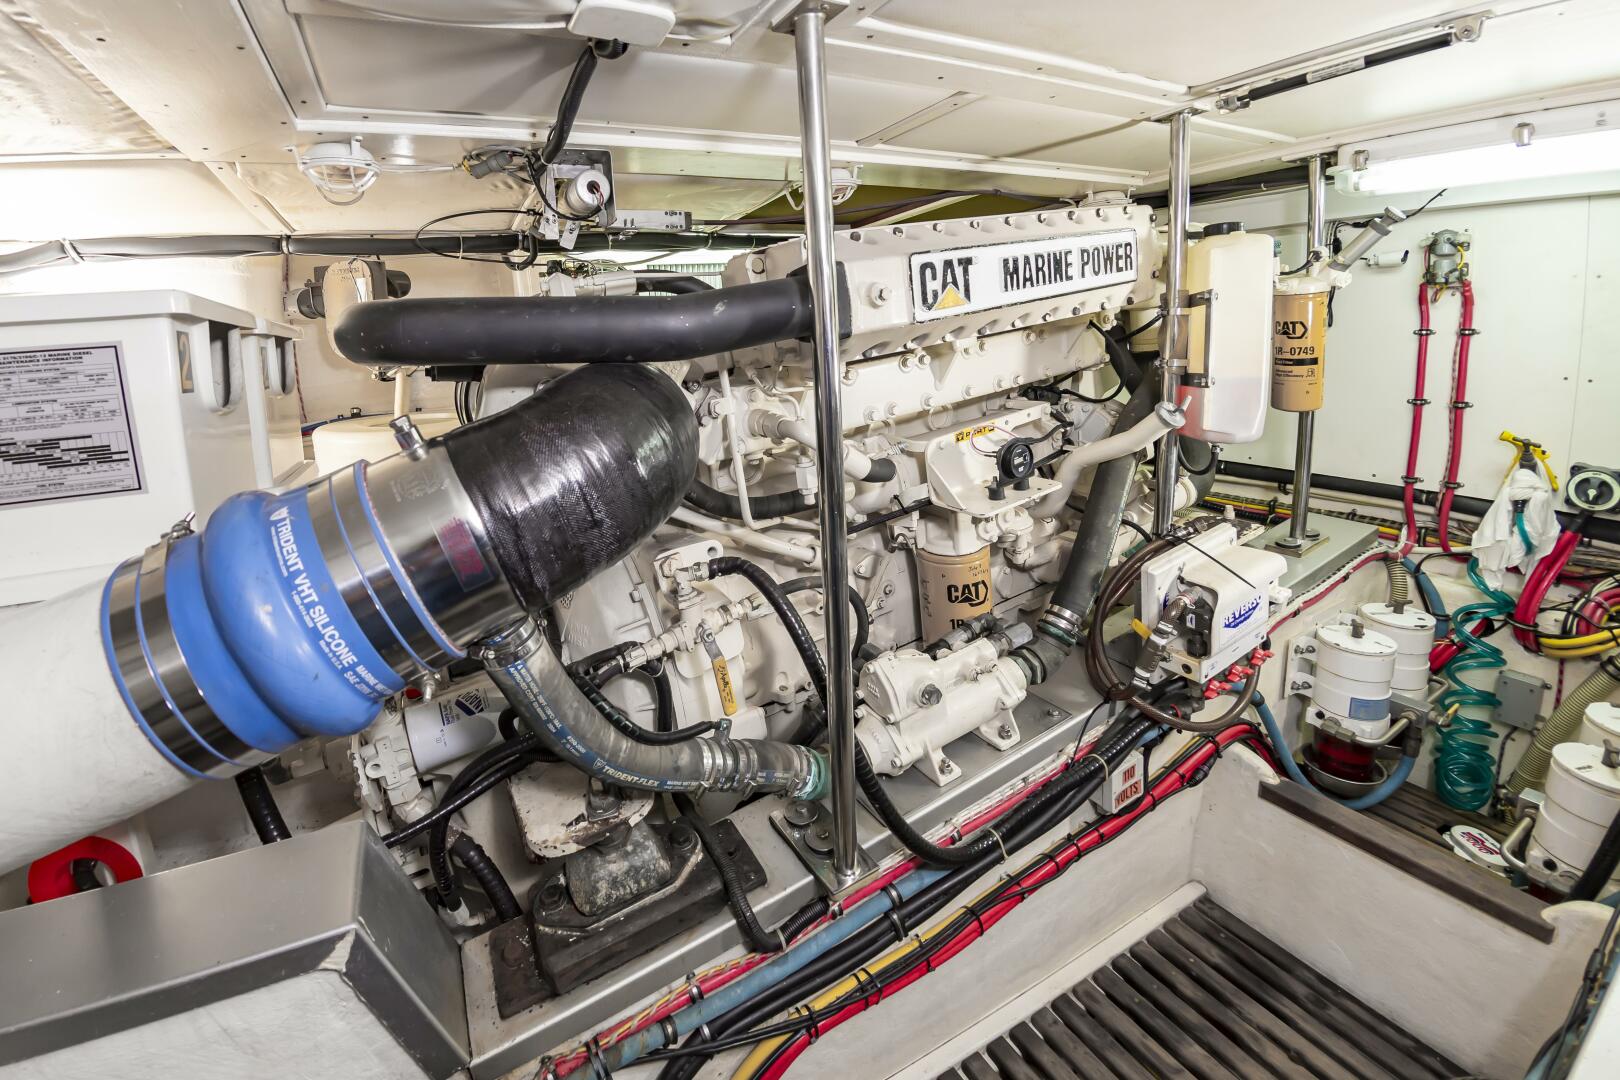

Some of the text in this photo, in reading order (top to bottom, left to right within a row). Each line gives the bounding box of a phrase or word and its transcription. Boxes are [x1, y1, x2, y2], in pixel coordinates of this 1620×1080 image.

[919, 241, 1133, 311] CAT MARINE POWER
[1275, 321, 1299, 336] CAT
[1275, 346, 1315, 356] 1R-0749
[277, 519, 358, 668] TRIDENT VHT SILICONE
[947, 582, 981, 604] CAT
[344, 670, 360, 685] SAE
[602, 765, 660, 788] TRIDENT-FLEX
[1115, 780, 1140, 807] VOLTS
